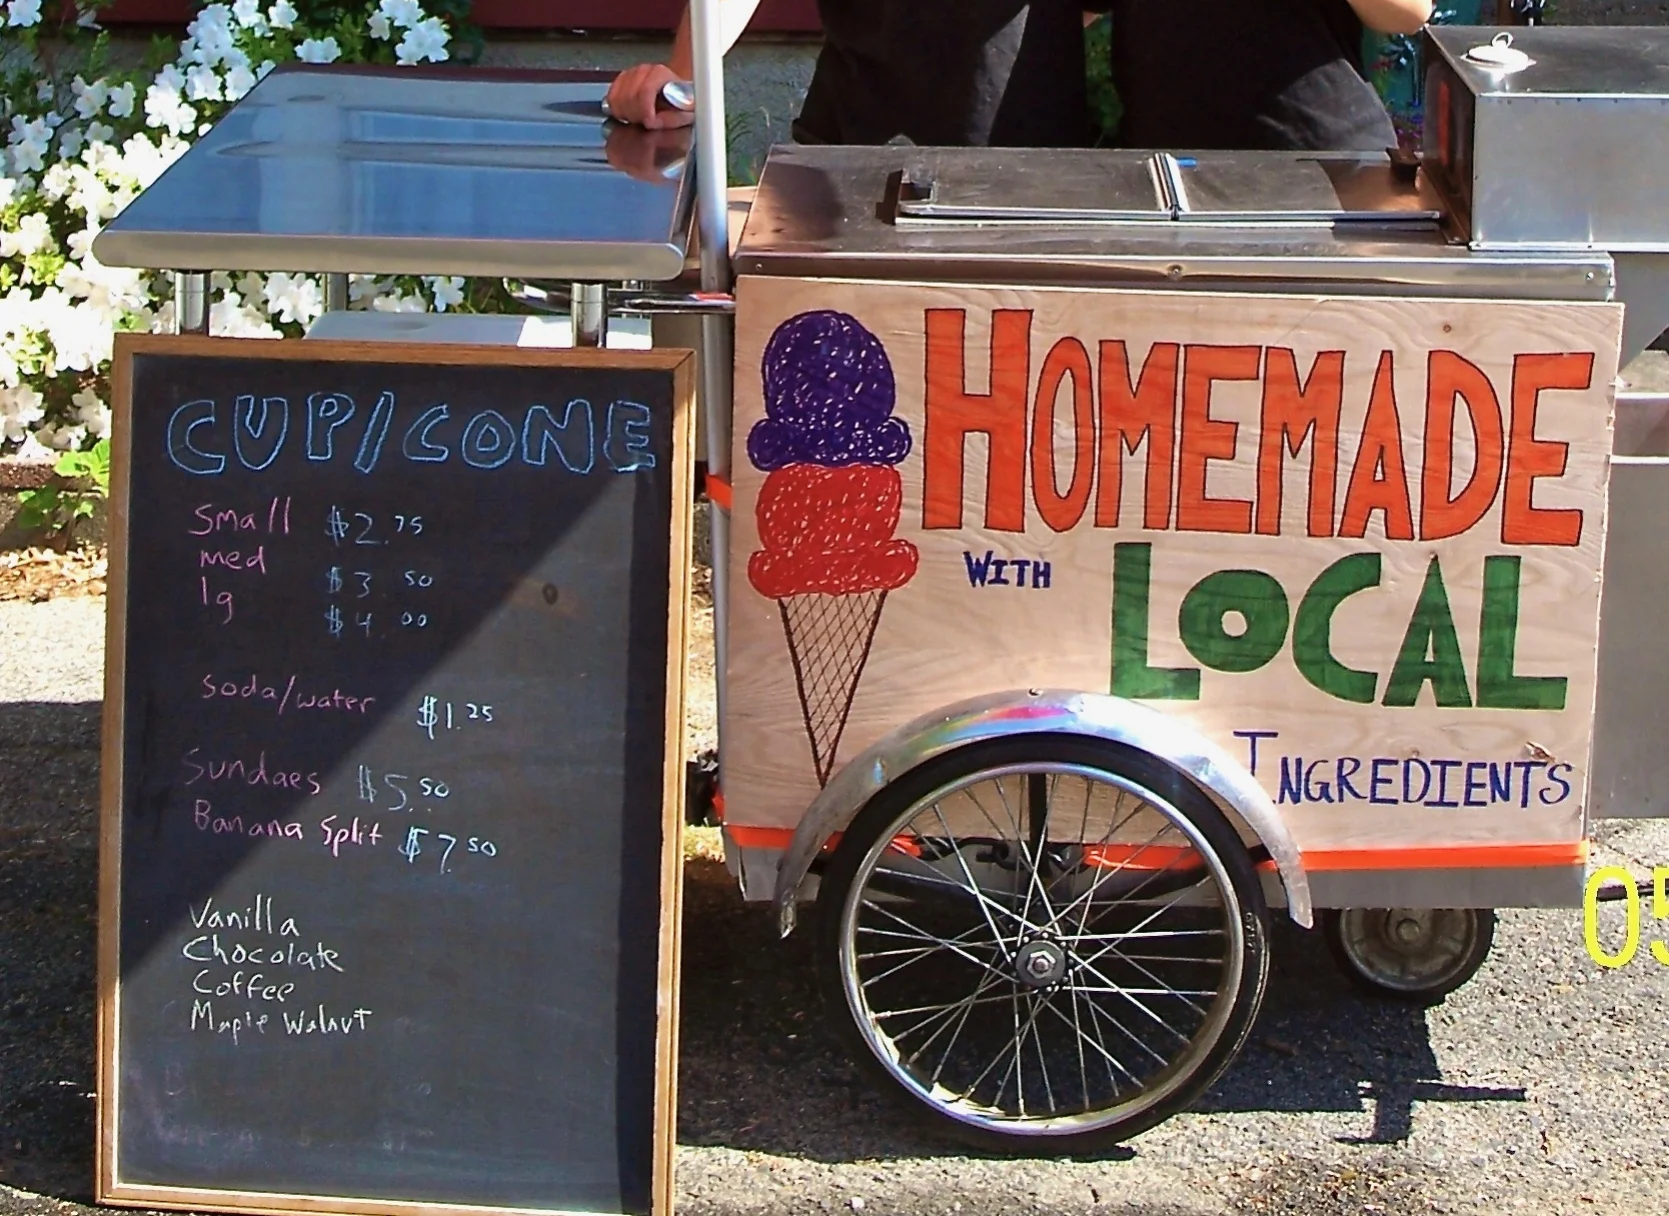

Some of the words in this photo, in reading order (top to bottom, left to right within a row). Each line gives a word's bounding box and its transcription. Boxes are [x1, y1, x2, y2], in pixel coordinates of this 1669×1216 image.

[922, 308, 1595, 546] HOMEMADE
[200, 547, 267, 575] med
[964, 550, 1051, 589] WITH
[1110, 542, 1568, 710] LOCAL
[1233, 730, 1572, 809] INGREDIENTS
[195, 799, 303, 840] Banana
[189, 893, 299, 937] Vanilla
[182, 934, 344, 972] Chocolate
[193, 969, 294, 1002] Coffee
[191, 999, 268, 1045] Maple
